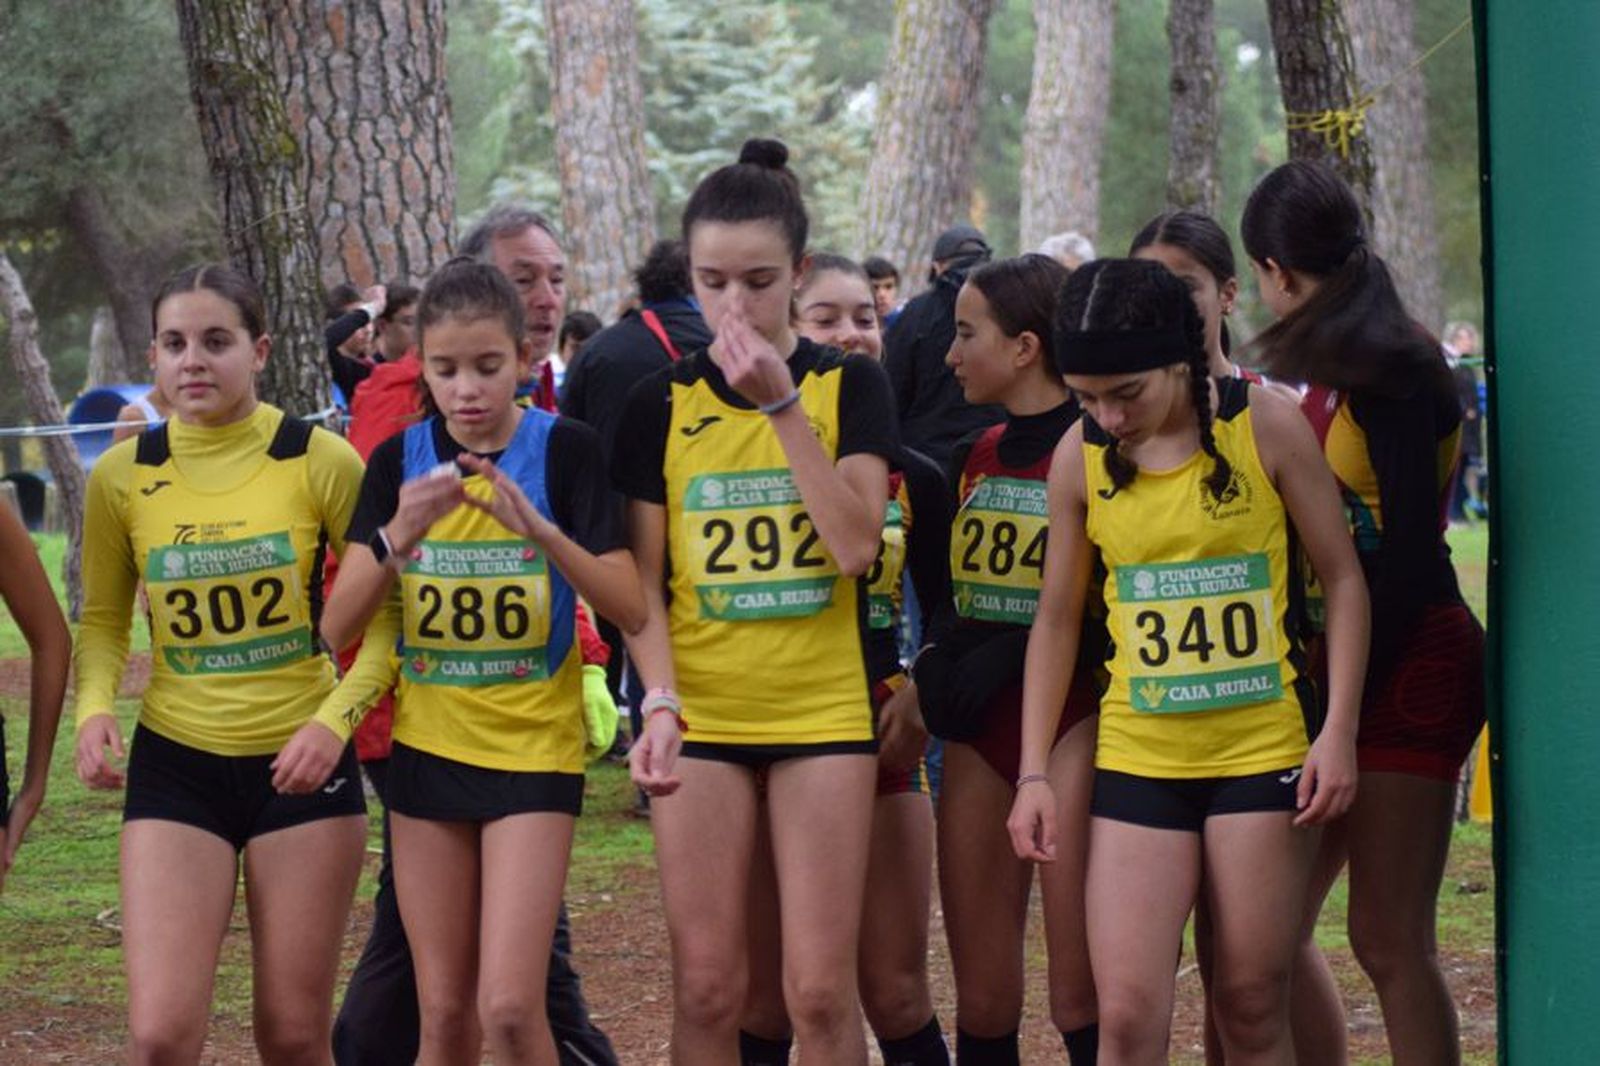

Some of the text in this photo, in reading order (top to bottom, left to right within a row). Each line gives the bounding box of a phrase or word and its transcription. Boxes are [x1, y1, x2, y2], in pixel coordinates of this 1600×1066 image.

[729, 491, 766, 505] CAJA
[703, 511, 826, 574] 292
[962, 517, 1049, 580] 284
[190, 554, 278, 577] CAJA RURAL
[437, 559, 524, 574] CAJA RURAL
[734, 592, 777, 609] CAJA
[1160, 577, 1251, 598] CAJA RURAL
[165, 577, 290, 639] 302
[417, 584, 529, 641] 286
[1136, 601, 1259, 667] 340
[205, 639, 304, 668] CAJA RURAL
[441, 661, 478, 675] CAJA
[1168, 675, 1273, 701] CAJA RURAL
